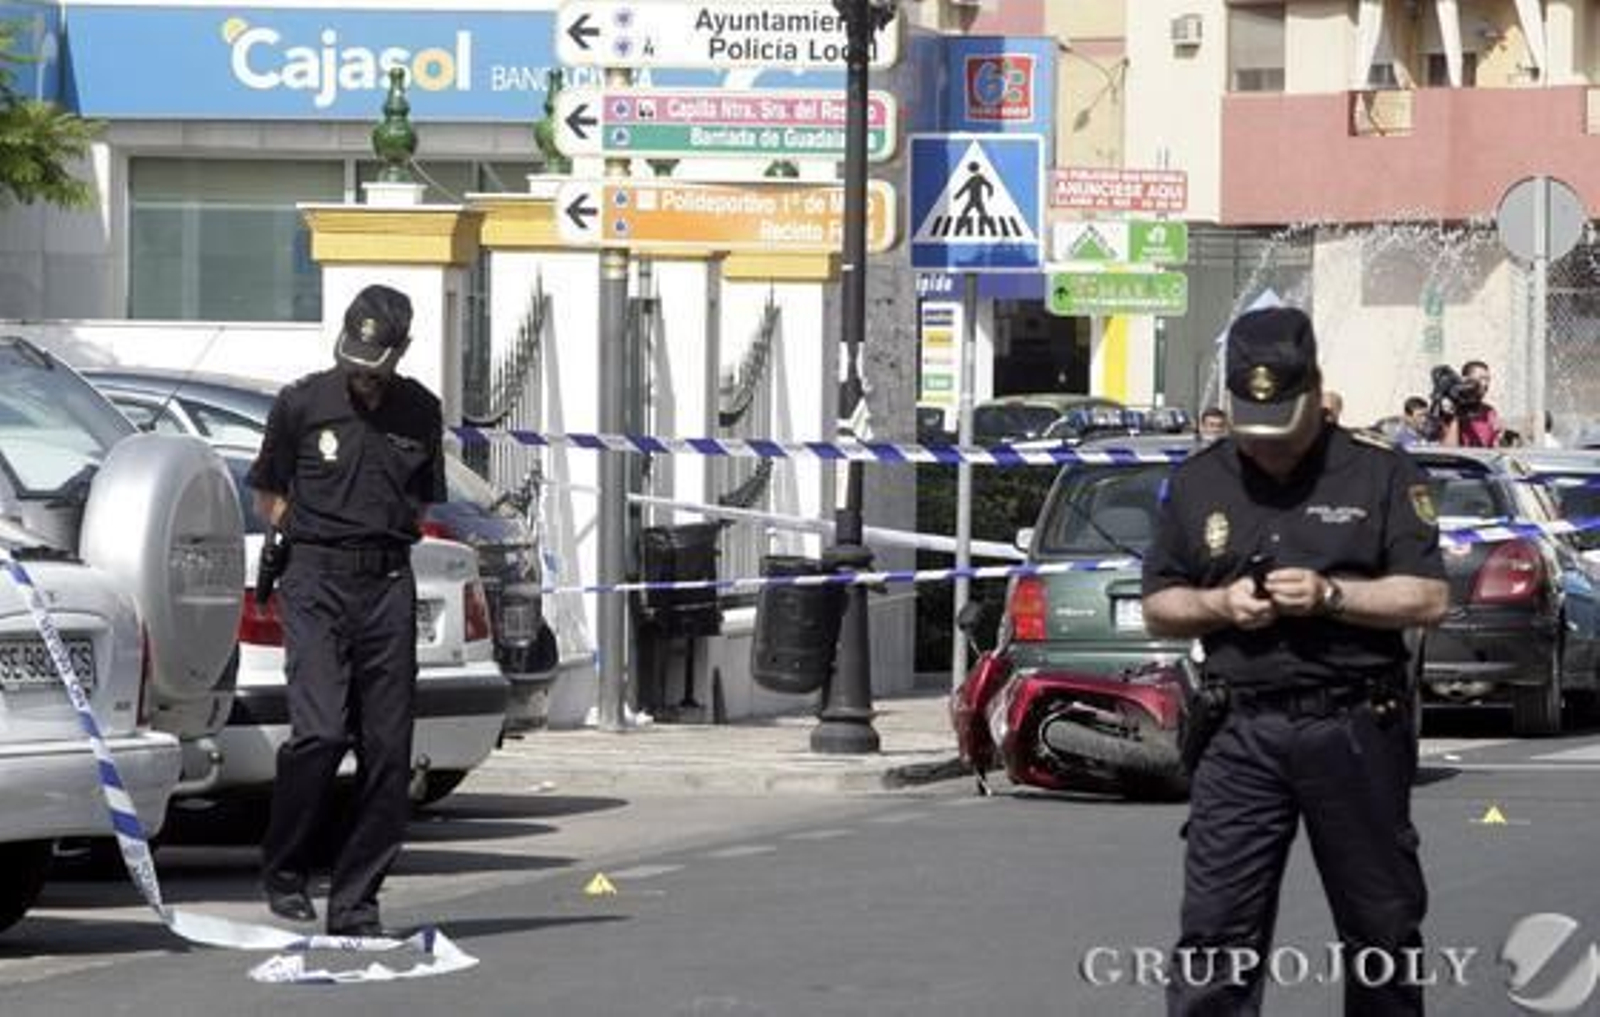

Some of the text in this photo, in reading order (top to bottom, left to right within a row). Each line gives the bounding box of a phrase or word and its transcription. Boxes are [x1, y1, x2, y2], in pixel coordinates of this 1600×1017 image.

[809, 39, 878, 62] Locl
[231, 27, 471, 108] Cajasol
[759, 129, 780, 148] de
[661, 190, 776, 215] Polideportivo
